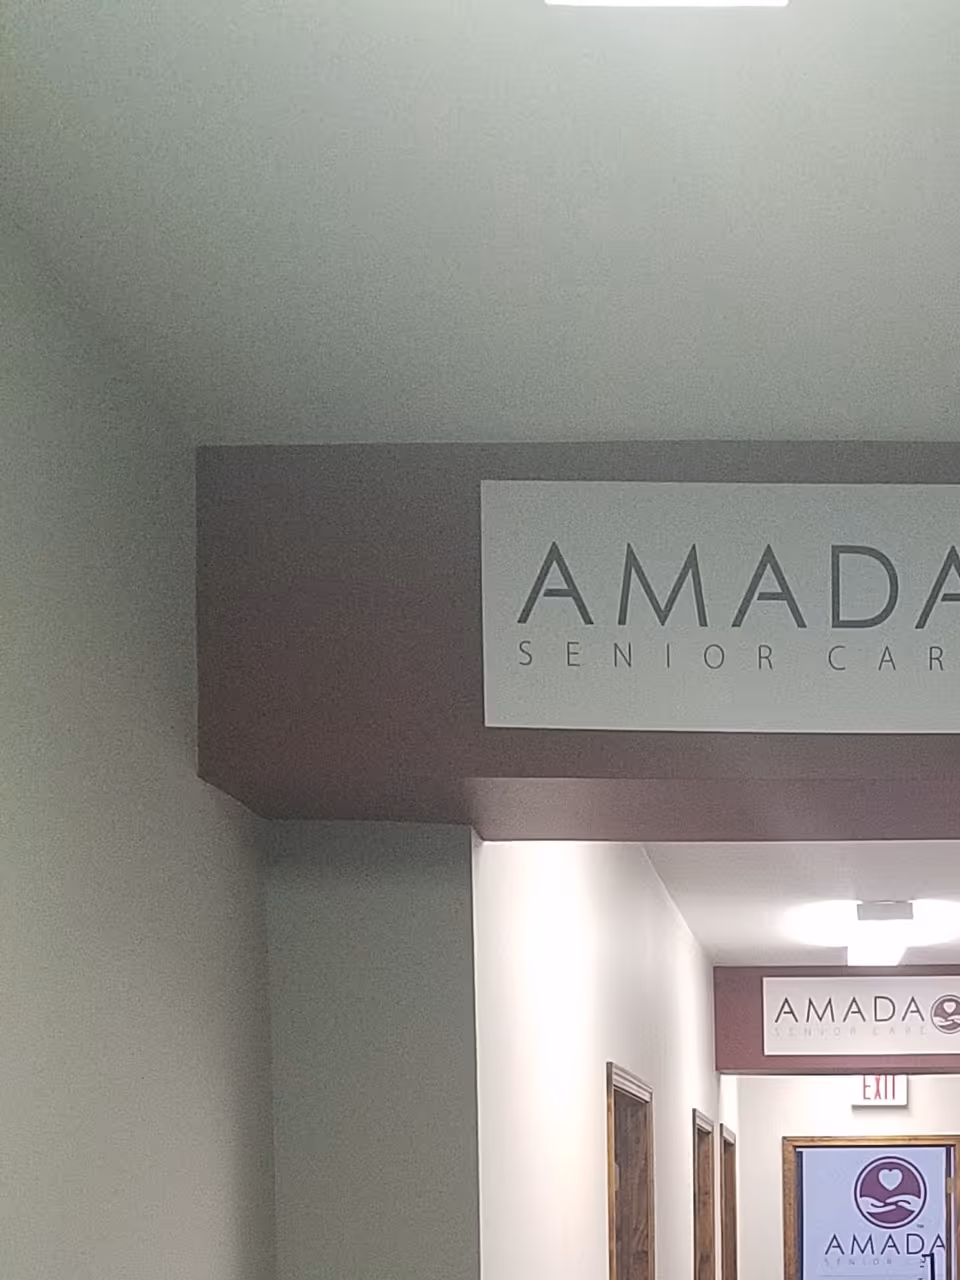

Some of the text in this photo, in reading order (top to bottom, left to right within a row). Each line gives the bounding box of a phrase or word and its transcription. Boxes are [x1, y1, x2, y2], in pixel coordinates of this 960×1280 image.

[518, 640, 774, 671] SENIOR
[774, 996, 925, 1023] AMADA
[863, 1075, 895, 1100] EXIT
[825, 1233, 945, 1255] AMADA
